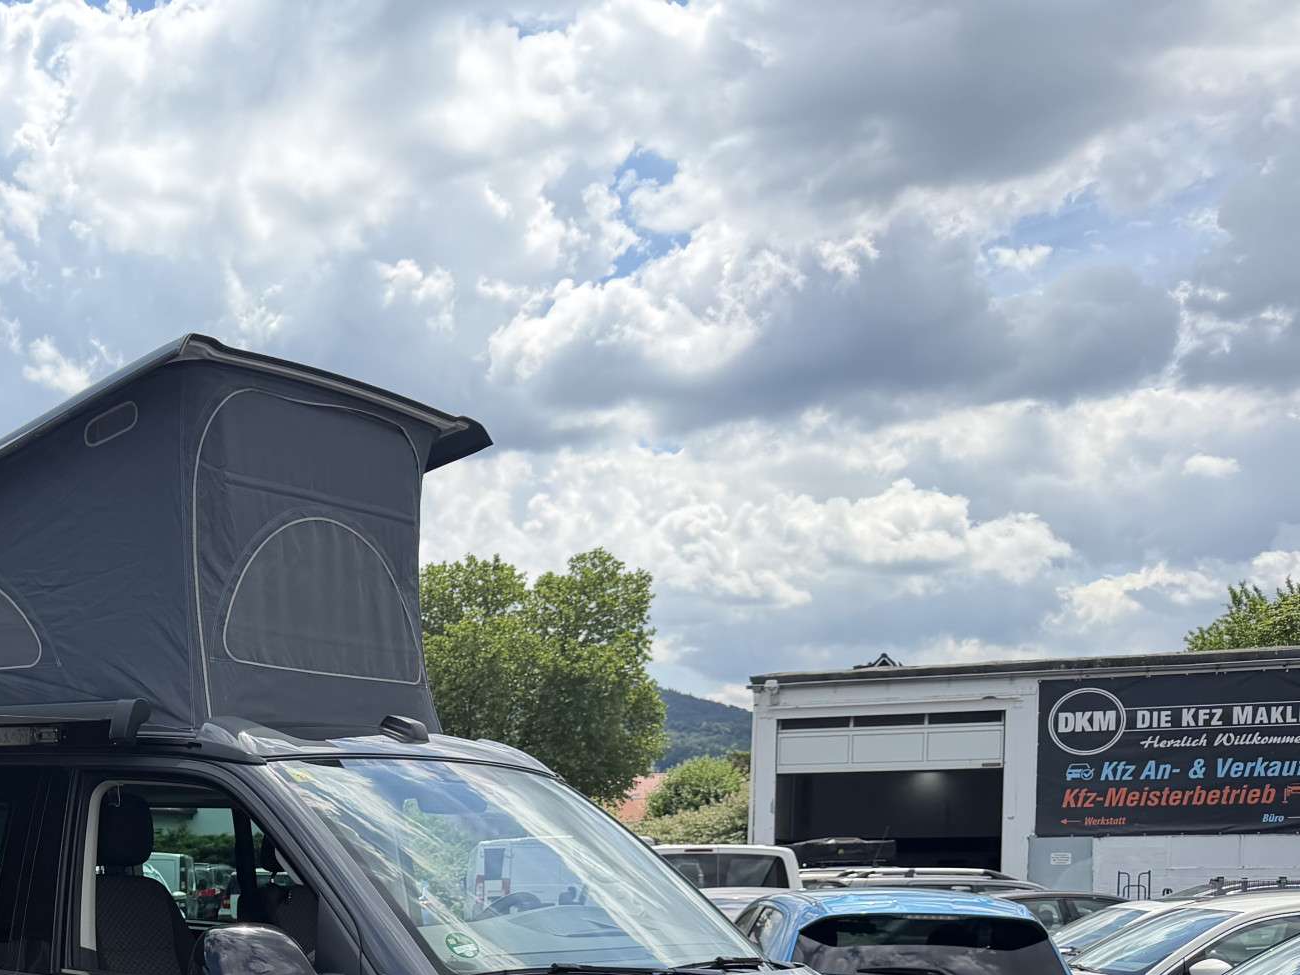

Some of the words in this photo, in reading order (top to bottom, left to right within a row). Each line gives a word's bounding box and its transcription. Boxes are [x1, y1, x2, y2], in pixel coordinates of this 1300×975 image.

[1057, 710, 1117, 733] DKM
[1136, 710, 1172, 728] DIE
[1232, 704, 1300, 725] MAKL
[1139, 735, 1207, 749] Herzlich
[1100, 761, 1136, 781] Kfz
[1140, 760, 1181, 780] An-
[1188, 758, 1206, 779] &
[1216, 756, 1300, 779] Verkau
[1061, 783, 1277, 809] Kfz-Meisterbetrieb
[1084, 815, 1127, 826] Werkstatt
[1262, 813, 1285, 824] Büro
